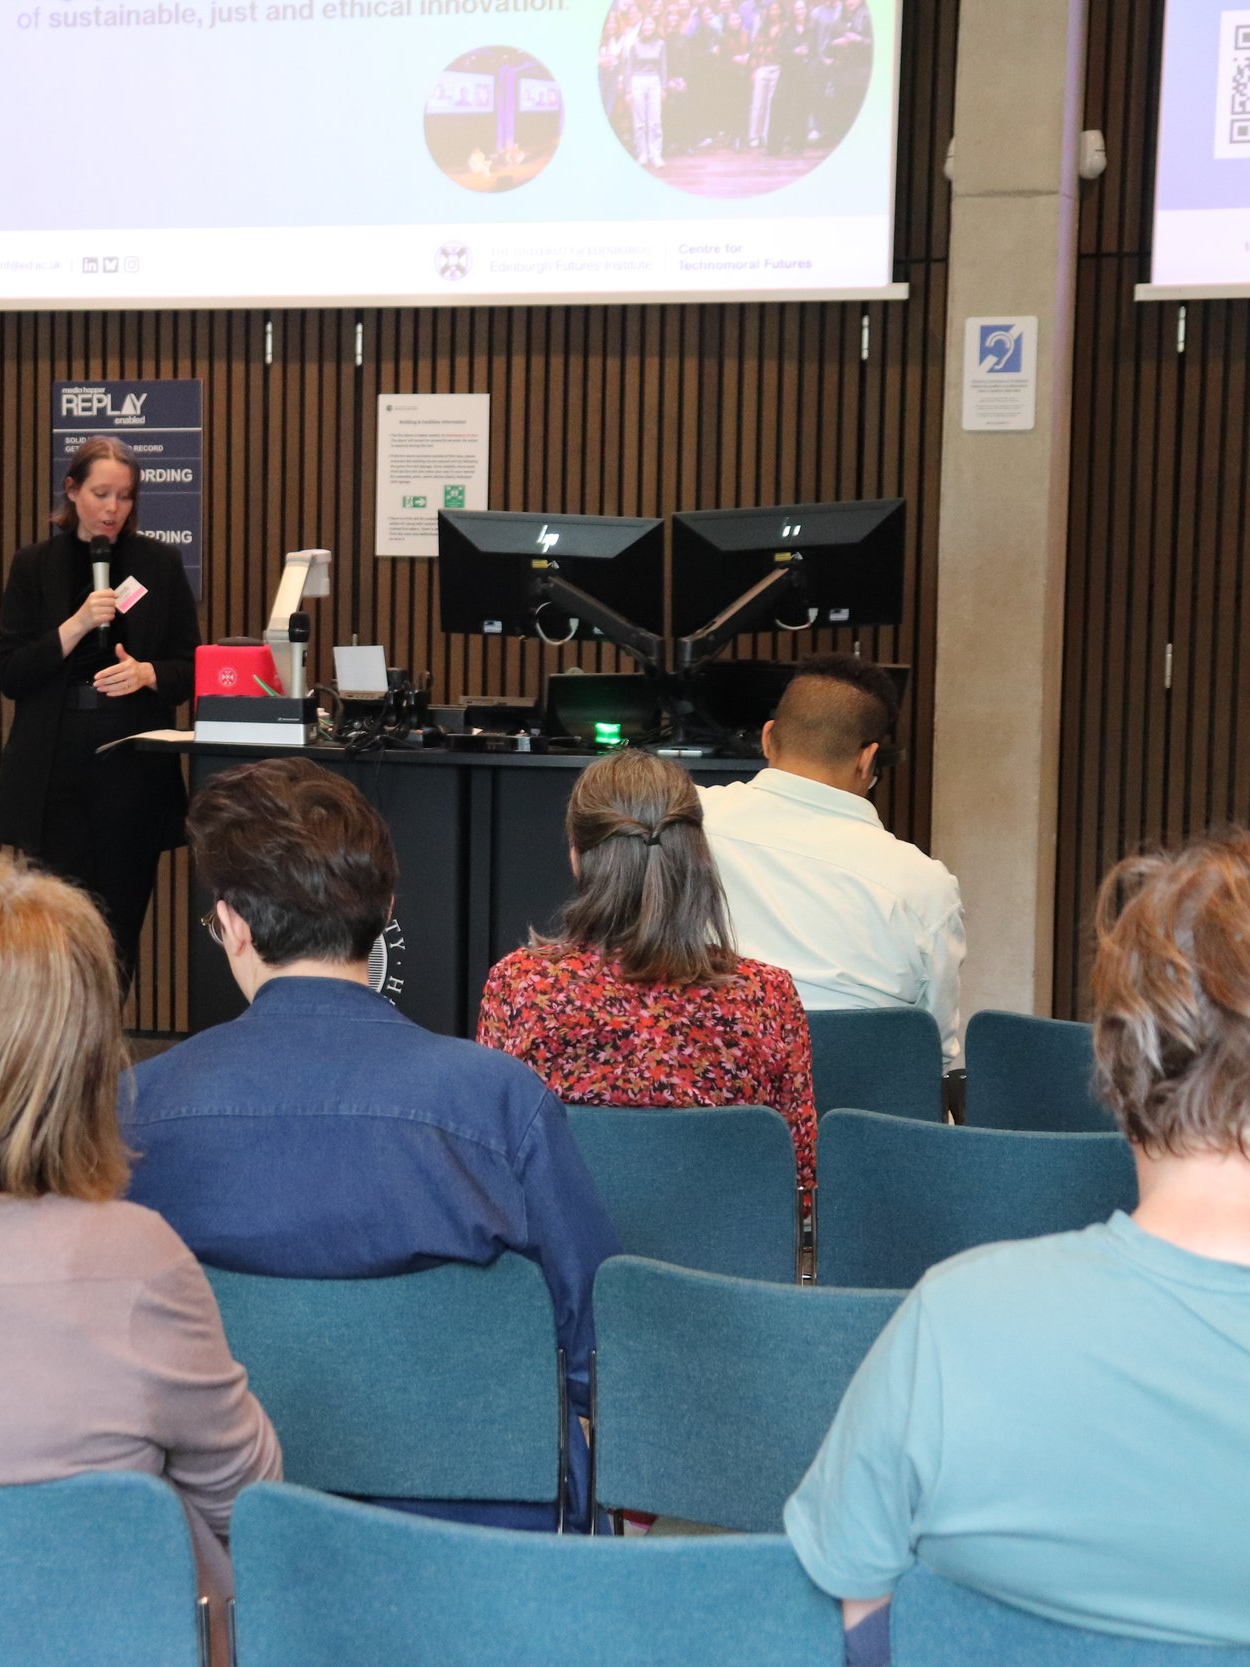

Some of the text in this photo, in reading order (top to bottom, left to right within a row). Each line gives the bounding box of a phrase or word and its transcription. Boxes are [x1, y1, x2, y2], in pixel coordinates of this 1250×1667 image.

[16, 6, 41, 30] of
[48, 2, 204, 29] sustainable,
[209, 0, 258, 28] just
[265, 0, 313, 21] and
[321, 0, 412, 19] ethical
[678, 242, 743, 255] Centre for
[489, 258, 653, 276] Edinburgh Futures Institute
[678, 257, 813, 272] Technomoral Futures
[61, 393, 148, 416] REPLAY
[114, 415, 146, 425] enabled
[133, 444, 164, 452] RECORD
